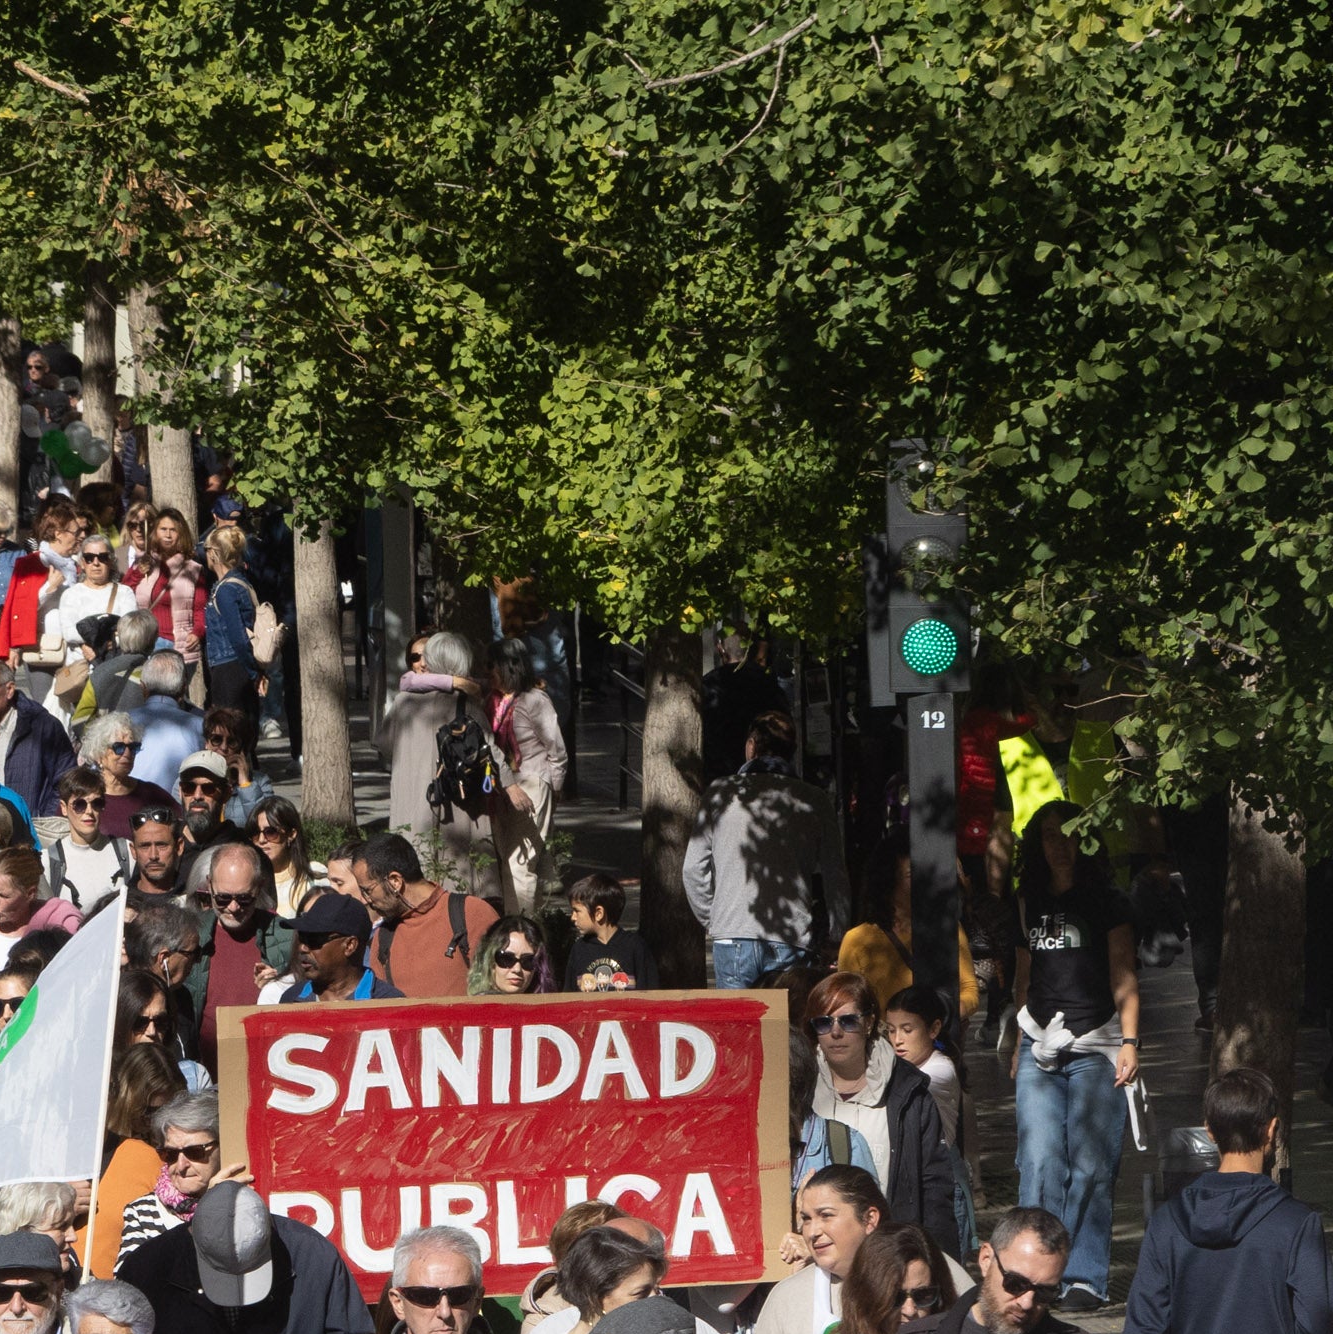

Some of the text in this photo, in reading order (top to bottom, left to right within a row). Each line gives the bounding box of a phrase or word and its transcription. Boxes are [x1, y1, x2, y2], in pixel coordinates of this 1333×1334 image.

[920, 711, 946, 730] 12
[1029, 937, 1065, 951] FACE
[266, 1021, 716, 1115] SANIDAD
